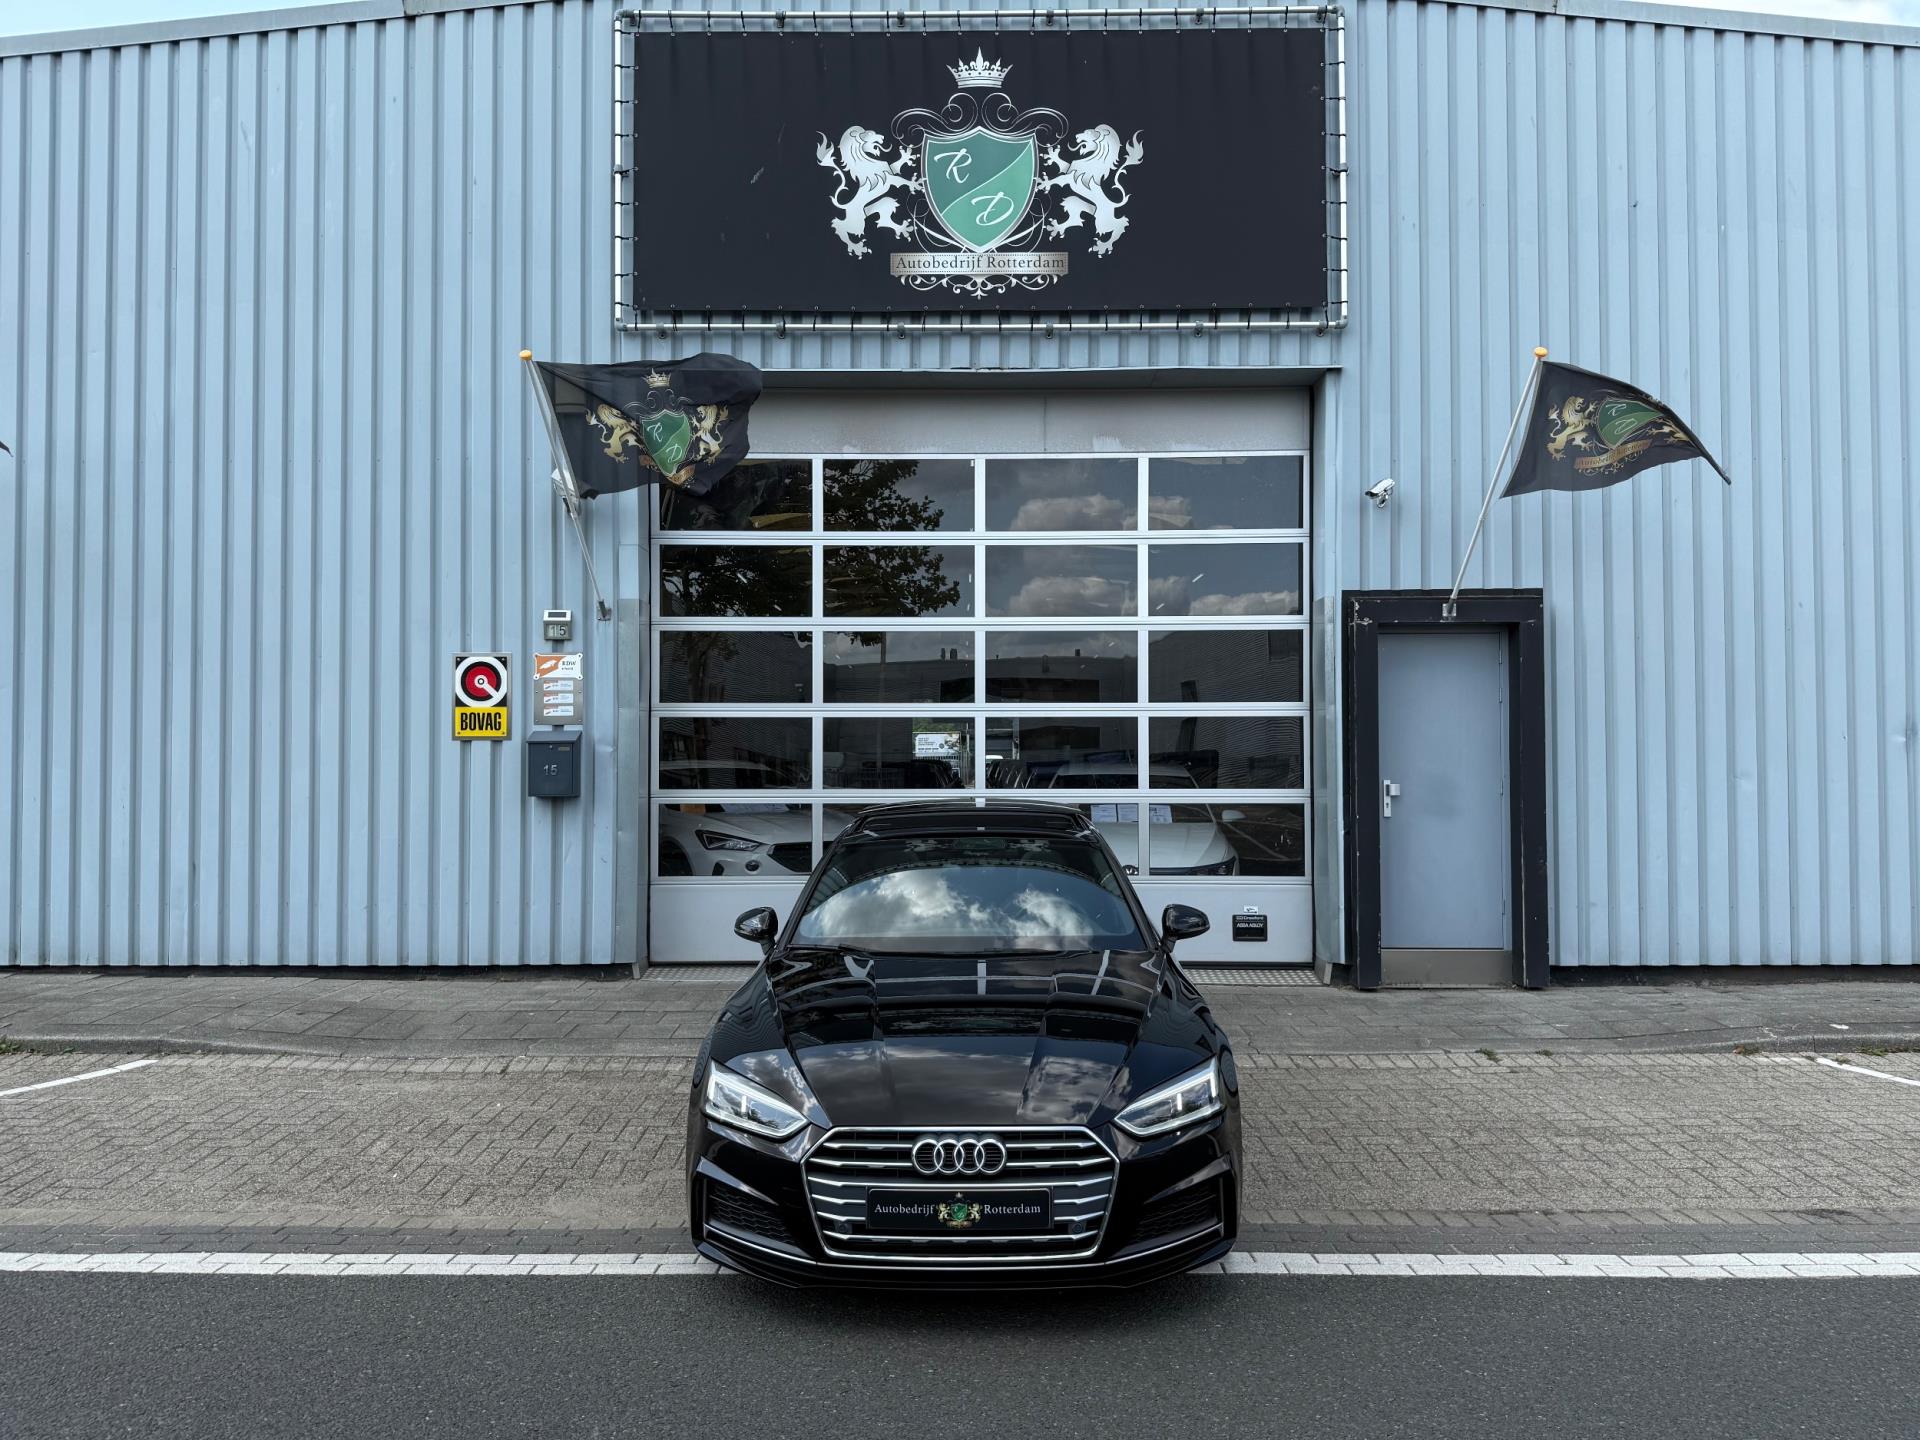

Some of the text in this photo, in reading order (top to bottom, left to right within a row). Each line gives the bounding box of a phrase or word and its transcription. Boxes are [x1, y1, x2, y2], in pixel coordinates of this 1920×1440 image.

[933, 147, 973, 184] R
[970, 191, 1015, 226] D
[896, 255, 1064, 273] Autobedrijf Rotterdam
[646, 422, 663, 442] R
[666, 443, 682, 463] D
[549, 625, 566, 637] 15
[460, 712, 502, 731] BOVAG
[543, 764, 558, 776] 15
[874, 1203, 1041, 1216] Autobedrijf Rotterdam
